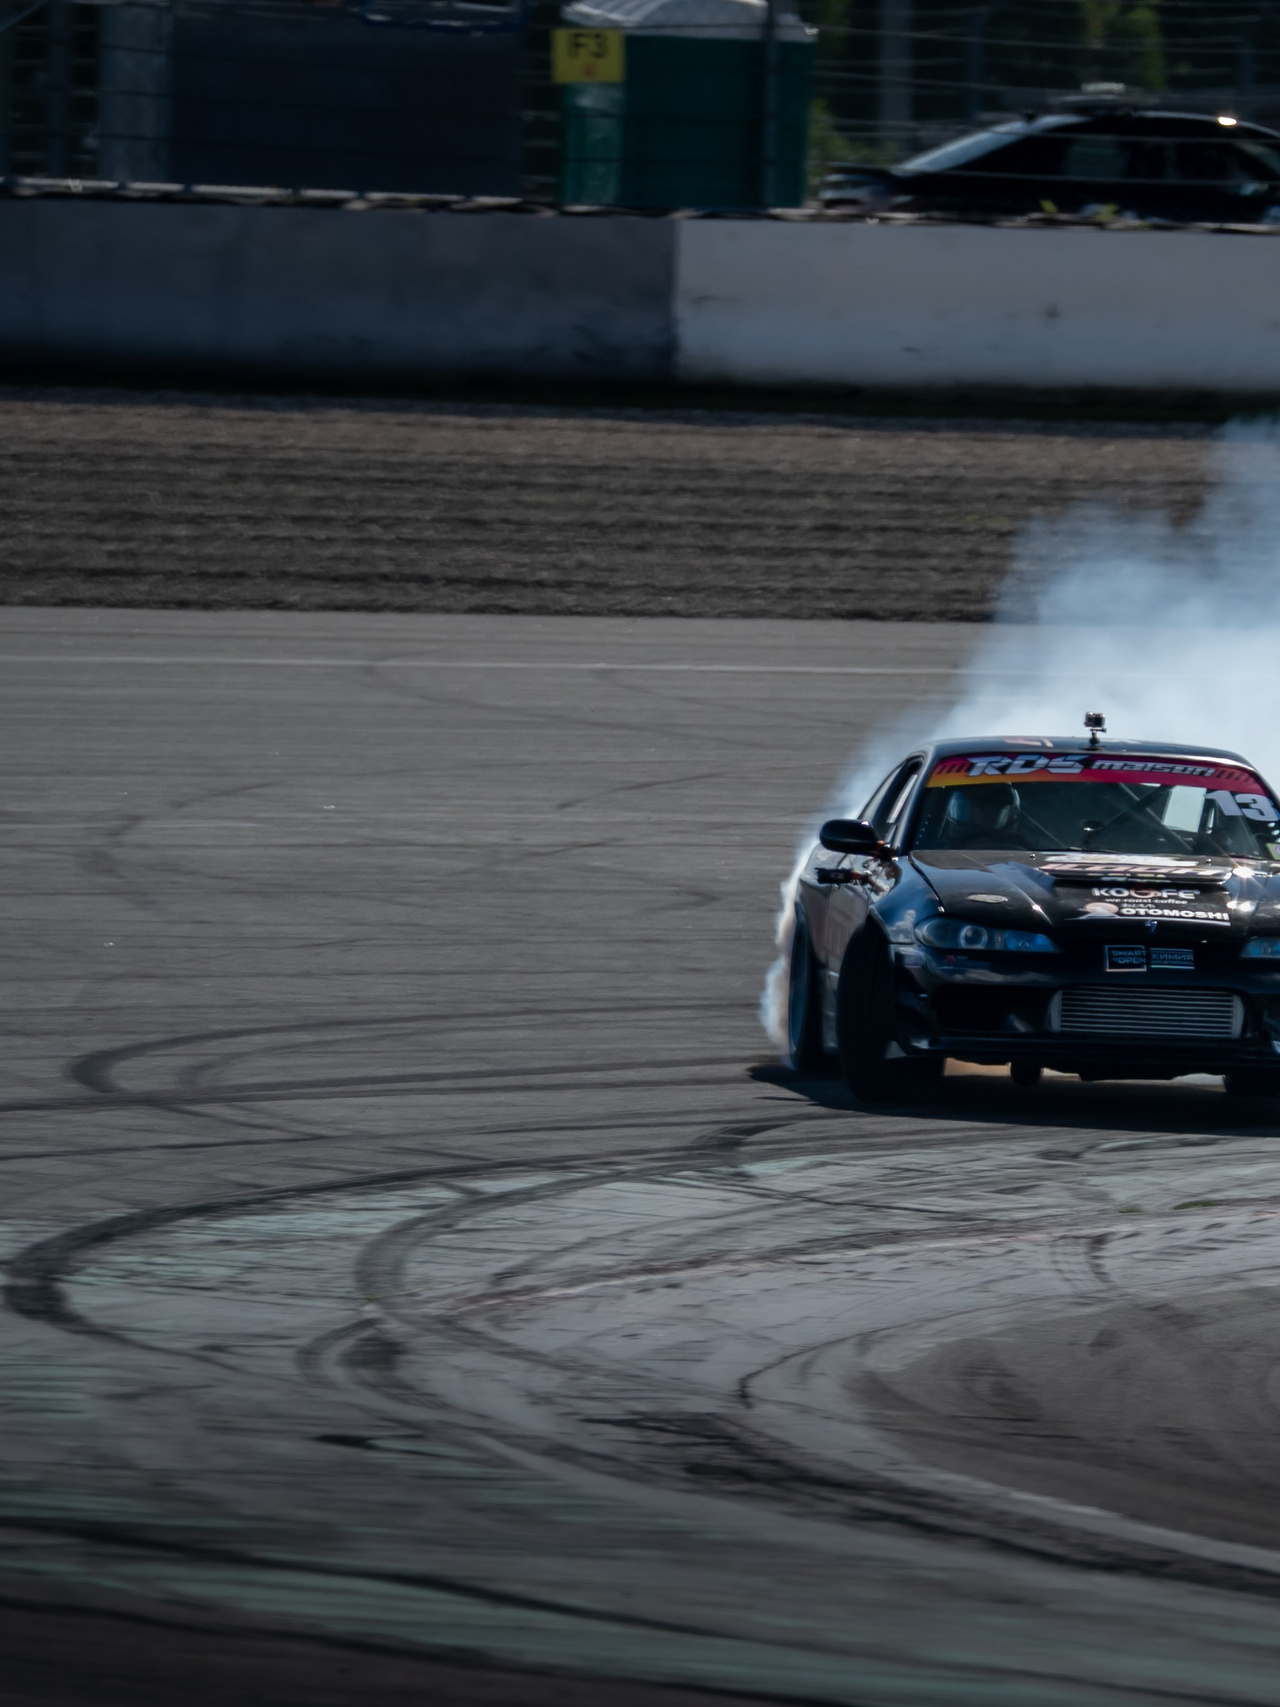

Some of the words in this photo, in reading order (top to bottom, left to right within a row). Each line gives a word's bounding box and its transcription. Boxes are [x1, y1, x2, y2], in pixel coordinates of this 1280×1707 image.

[568, 32, 610, 58] F3
[966, 753, 1093, 777] RDS
[1120, 908, 1231, 921] OTOMOSHI
